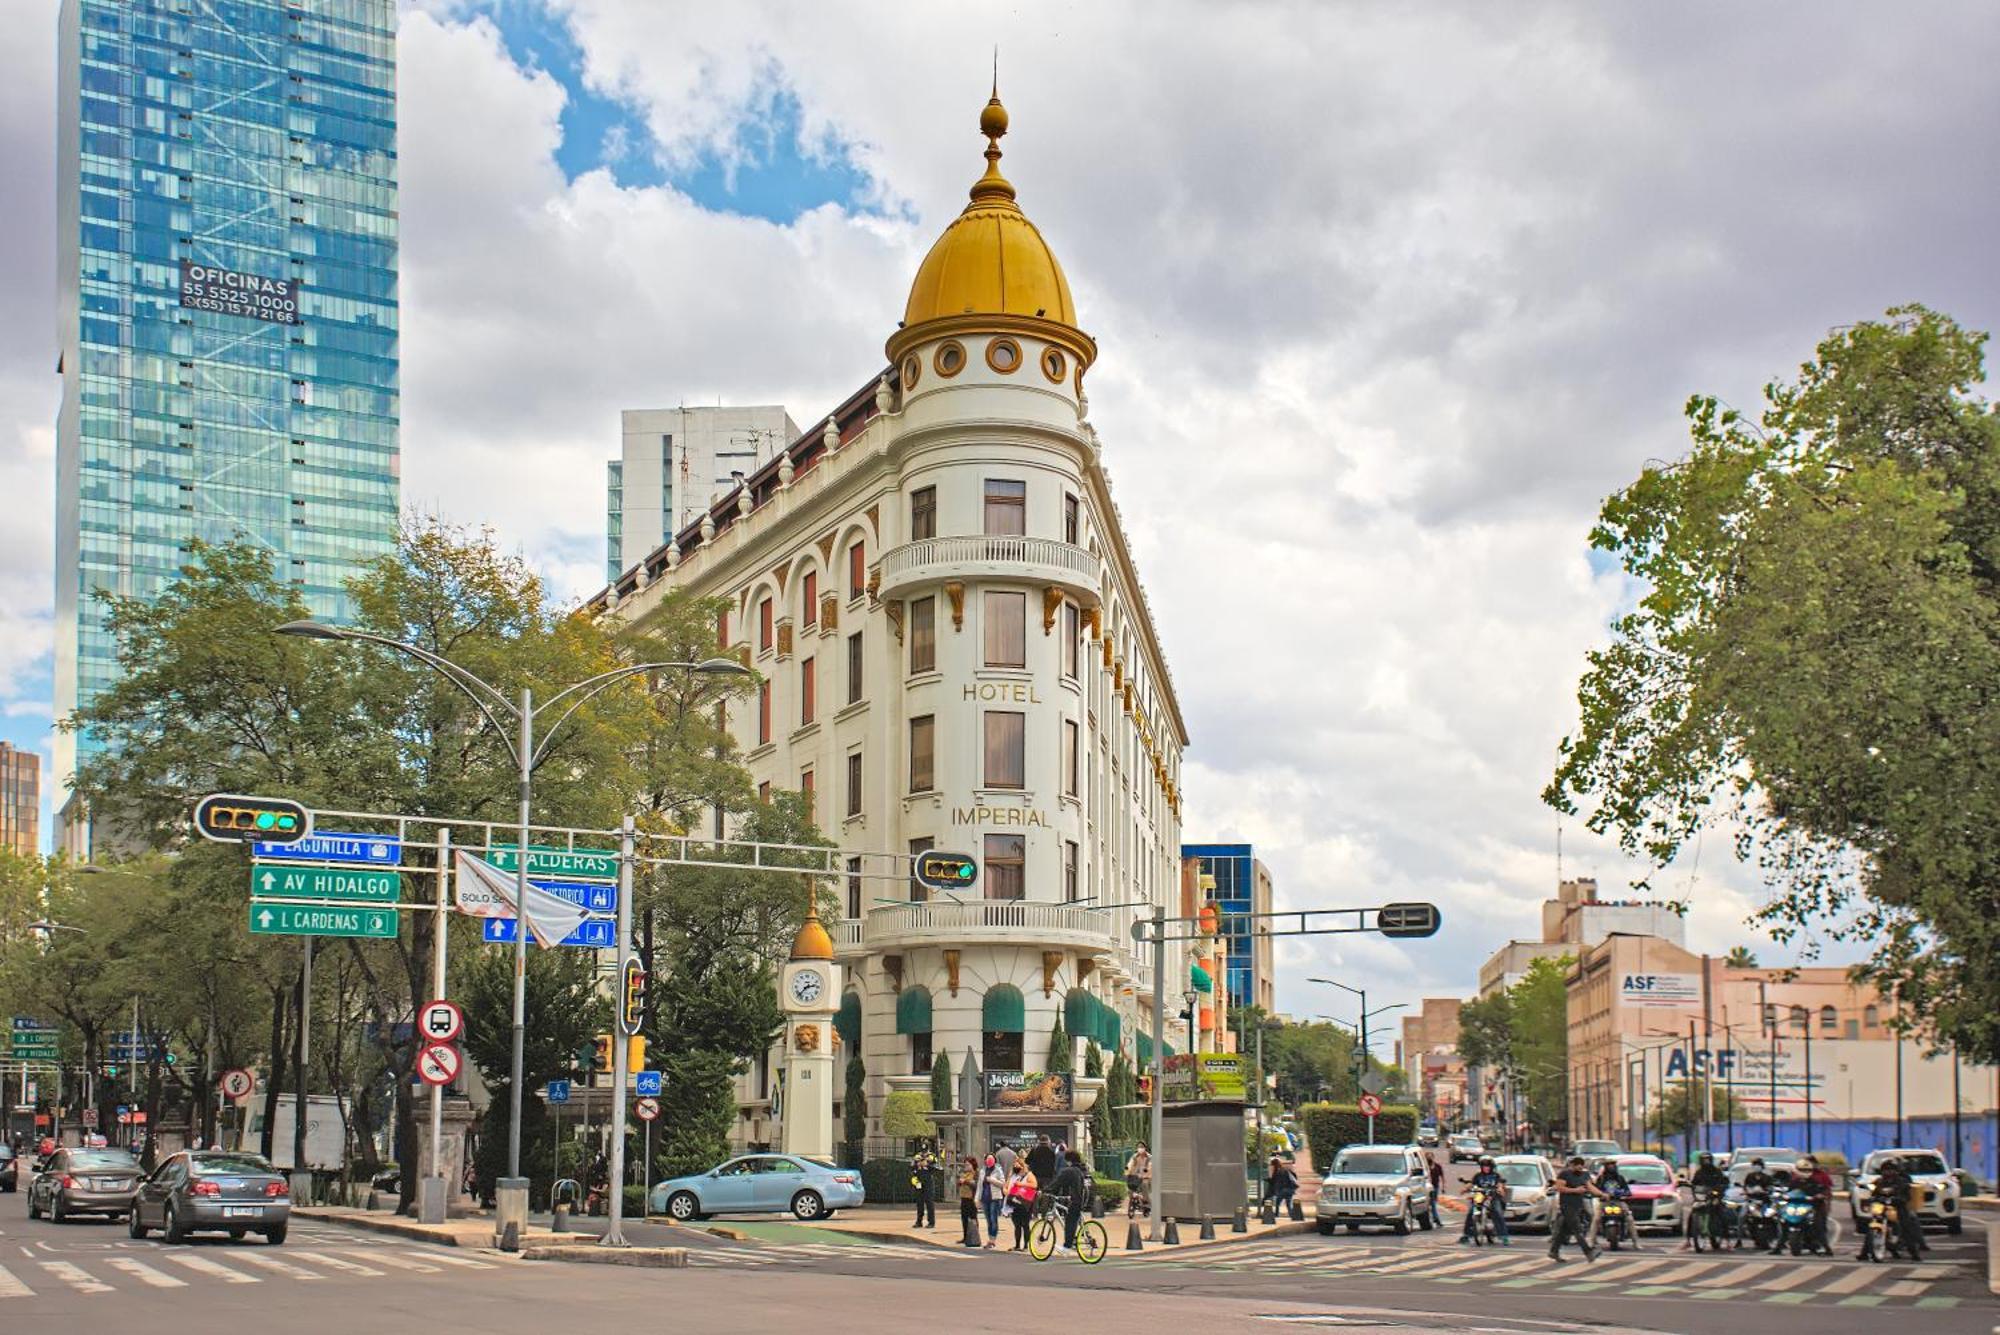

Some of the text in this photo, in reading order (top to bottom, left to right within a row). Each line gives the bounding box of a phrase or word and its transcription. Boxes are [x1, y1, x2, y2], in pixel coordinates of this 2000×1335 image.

[190, 267, 288, 295] OFICINAS
[183, 282, 295, 311] 55 5525 1000
[196, 298, 294, 322] (55) 15 71 21 66
[963, 684, 1042, 703] HOTEL
[952, 807, 1052, 829] IMPERIAL
[284, 874, 390, 894] AV HIDALGO
[461, 893, 490, 903] SOLO
[281, 912, 359, 930] L CARDENAS
[1623, 976, 1656, 989] ASF
[1665, 1048, 1736, 1078] ASF
[1744, 1060, 1785, 1070] Superor
